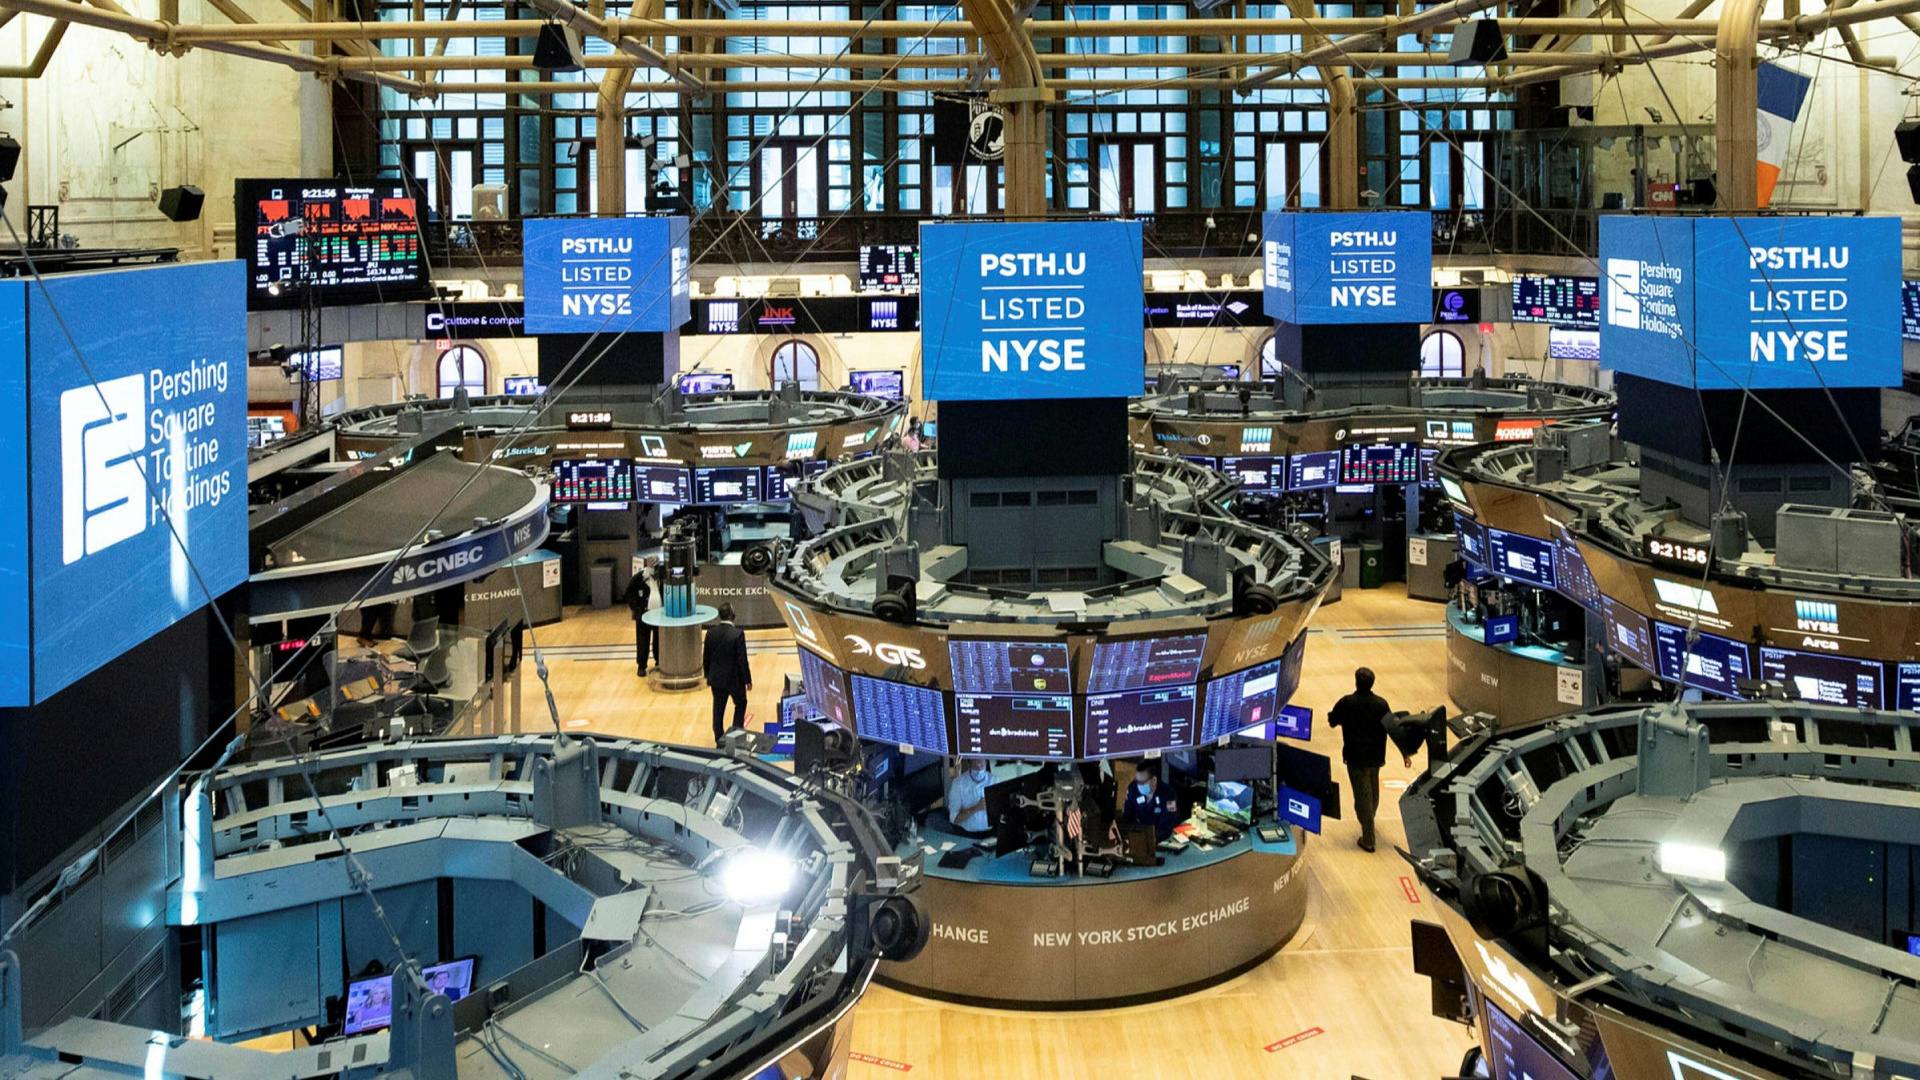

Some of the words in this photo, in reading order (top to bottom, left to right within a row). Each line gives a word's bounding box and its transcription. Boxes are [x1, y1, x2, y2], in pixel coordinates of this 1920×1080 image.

[302, 189, 336, 198] 9:21:56
[1652, 191, 1673, 202] CNN
[562, 238, 632, 253] PSTH.U
[1330, 231, 1397, 248] PSTH.U
[981, 252, 1086, 277] PSTH.U
[1331, 259, 1396, 275] LISTED
[1750, 246, 1849, 269] PSTH.U
[562, 267, 631, 282] LISTED
[884, 275, 898, 283] 3M
[1641, 260, 1681, 285] Pershing
[1331, 286, 1397, 307] NYSE
[1641, 279, 1674, 299] Square
[563, 293, 632, 315] NYSE
[981, 297, 1085, 320] LISTED
[1641, 296, 1676, 317] Tontine
[1750, 289, 1848, 311] LISTED
[481, 316, 487, 325] &
[489, 317, 524, 329] compan
[760, 307, 793, 318] JNK
[1531, 308, 1544, 316] 3M
[709, 322, 739, 331] NYSE
[872, 319, 898, 328] NYSE
[1641, 314, 1683, 339] Holdings
[981, 339, 1086, 372] NYSE
[1750, 330, 1848, 362] NYSE
[150, 358, 228, 404] Pershing
[150, 402, 215, 444] Square
[1240, 443, 1271, 452] NYSE
[150, 438, 218, 484] Totine
[151, 470, 230, 526] Hodings
[417, 546, 484, 578] CNBC
[513, 524, 531, 546] NYSE
[1650, 541, 1707, 564] 9:21:56
[471, 588, 521, 601] EXCHANGE
[696, 587, 710, 595] ORK
[713, 587, 742, 596] STOCK
[745, 587, 770, 595] EXCH
[1798, 619, 1839, 634] NYSE
[1233, 643, 1270, 664] NYSE
[1803, 636, 1839, 650] Arca
[875, 643, 926, 669] GTS
[1149, 671, 1191, 682] ExxonMobil
[1481, 673, 1499, 687] NEW
[1273, 870, 1290, 894] NEW
[1291, 856, 1305, 878] YOR
[1033, 933, 1072, 947] NEW
[1078, 929, 1123, 946] YORK
[1127, 920, 1178, 942] STOCK
[1182, 897, 1250, 929] EXCHANGE
[932, 923, 989, 945] HANGE
